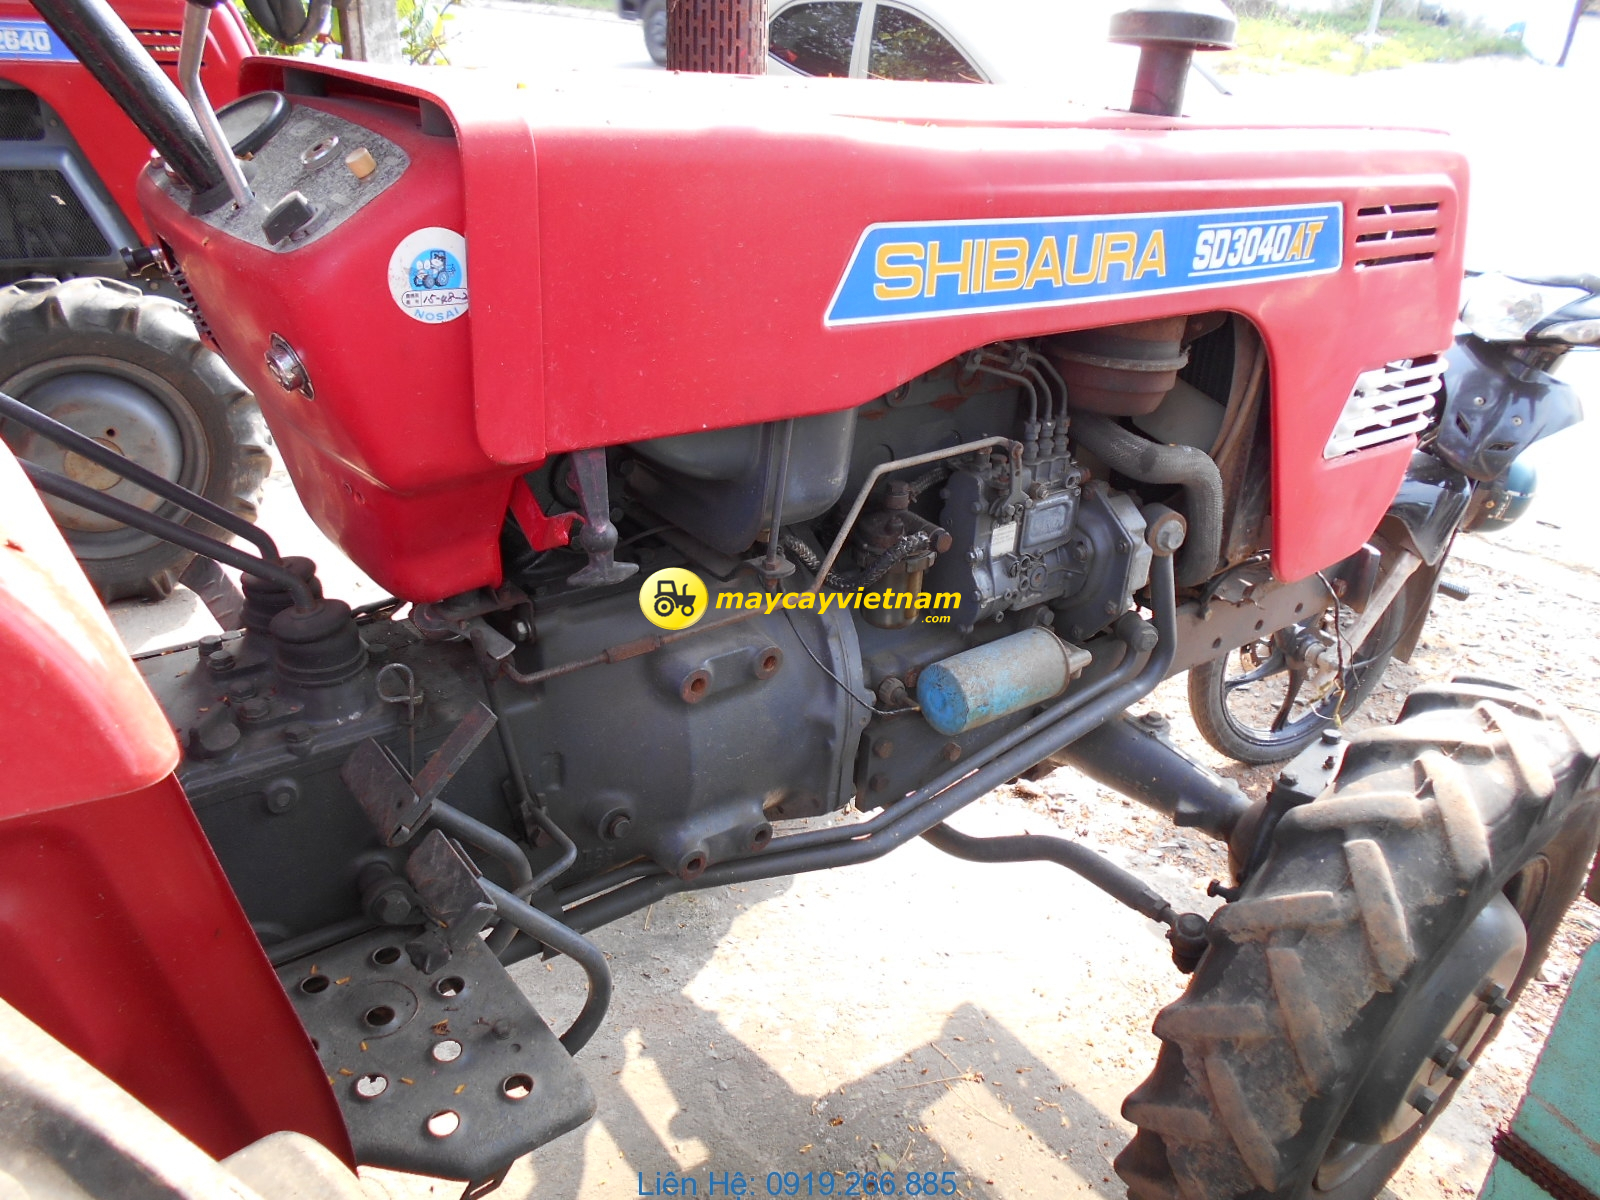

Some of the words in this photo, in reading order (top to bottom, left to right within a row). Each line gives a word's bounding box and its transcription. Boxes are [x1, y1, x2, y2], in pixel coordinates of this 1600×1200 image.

[873, 229, 1167, 301] SHIBAURA
[1193, 221, 1324, 271] SD3040AT
[414, 307, 460, 321] NOSAI
